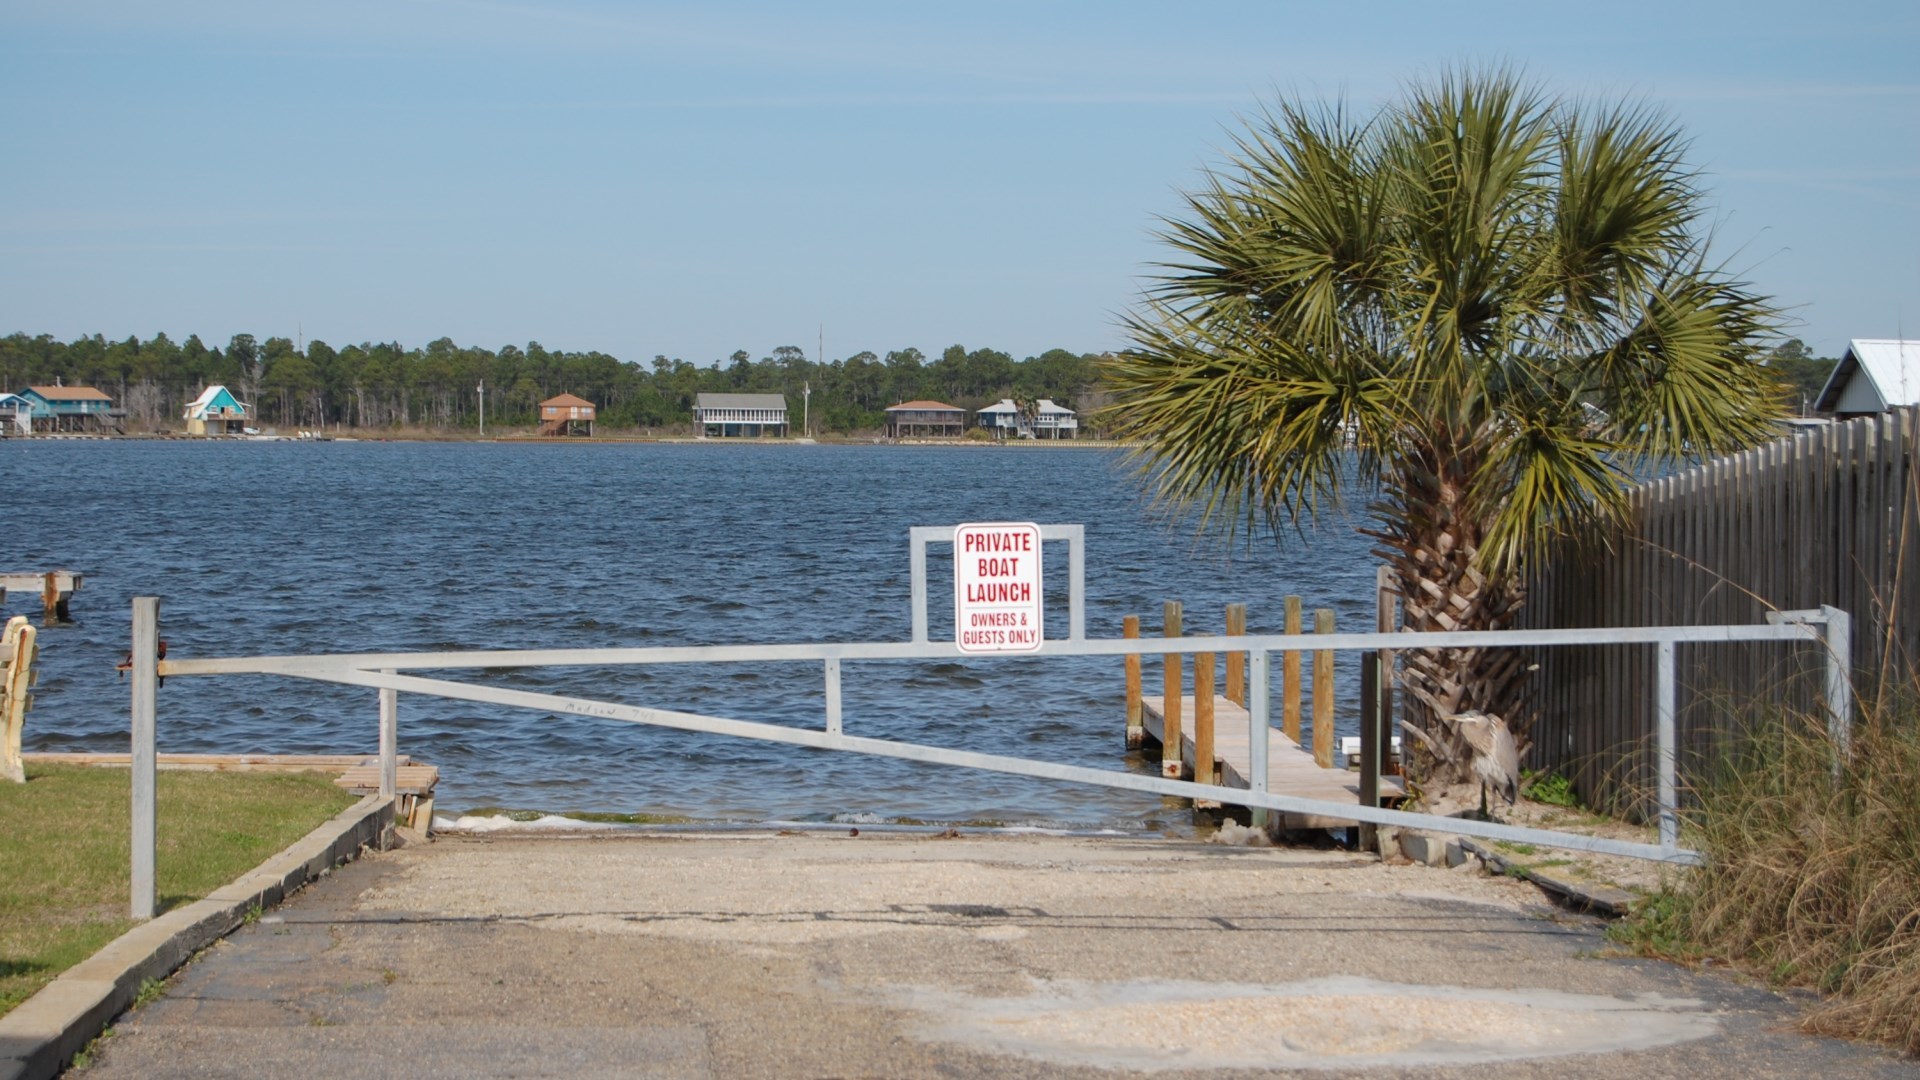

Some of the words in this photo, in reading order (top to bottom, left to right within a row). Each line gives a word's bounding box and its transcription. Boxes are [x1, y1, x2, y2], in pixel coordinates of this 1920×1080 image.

[965, 533, 1031, 552] PRIVATE
[978, 558, 1019, 577] BOAT
[967, 583, 1030, 602] LAUNCH
[971, 613, 1017, 627] OWNERS
[1020, 612, 1027, 626] &
[963, 631, 1005, 644] GUESTS
[1009, 629, 1036, 644] ONLY
